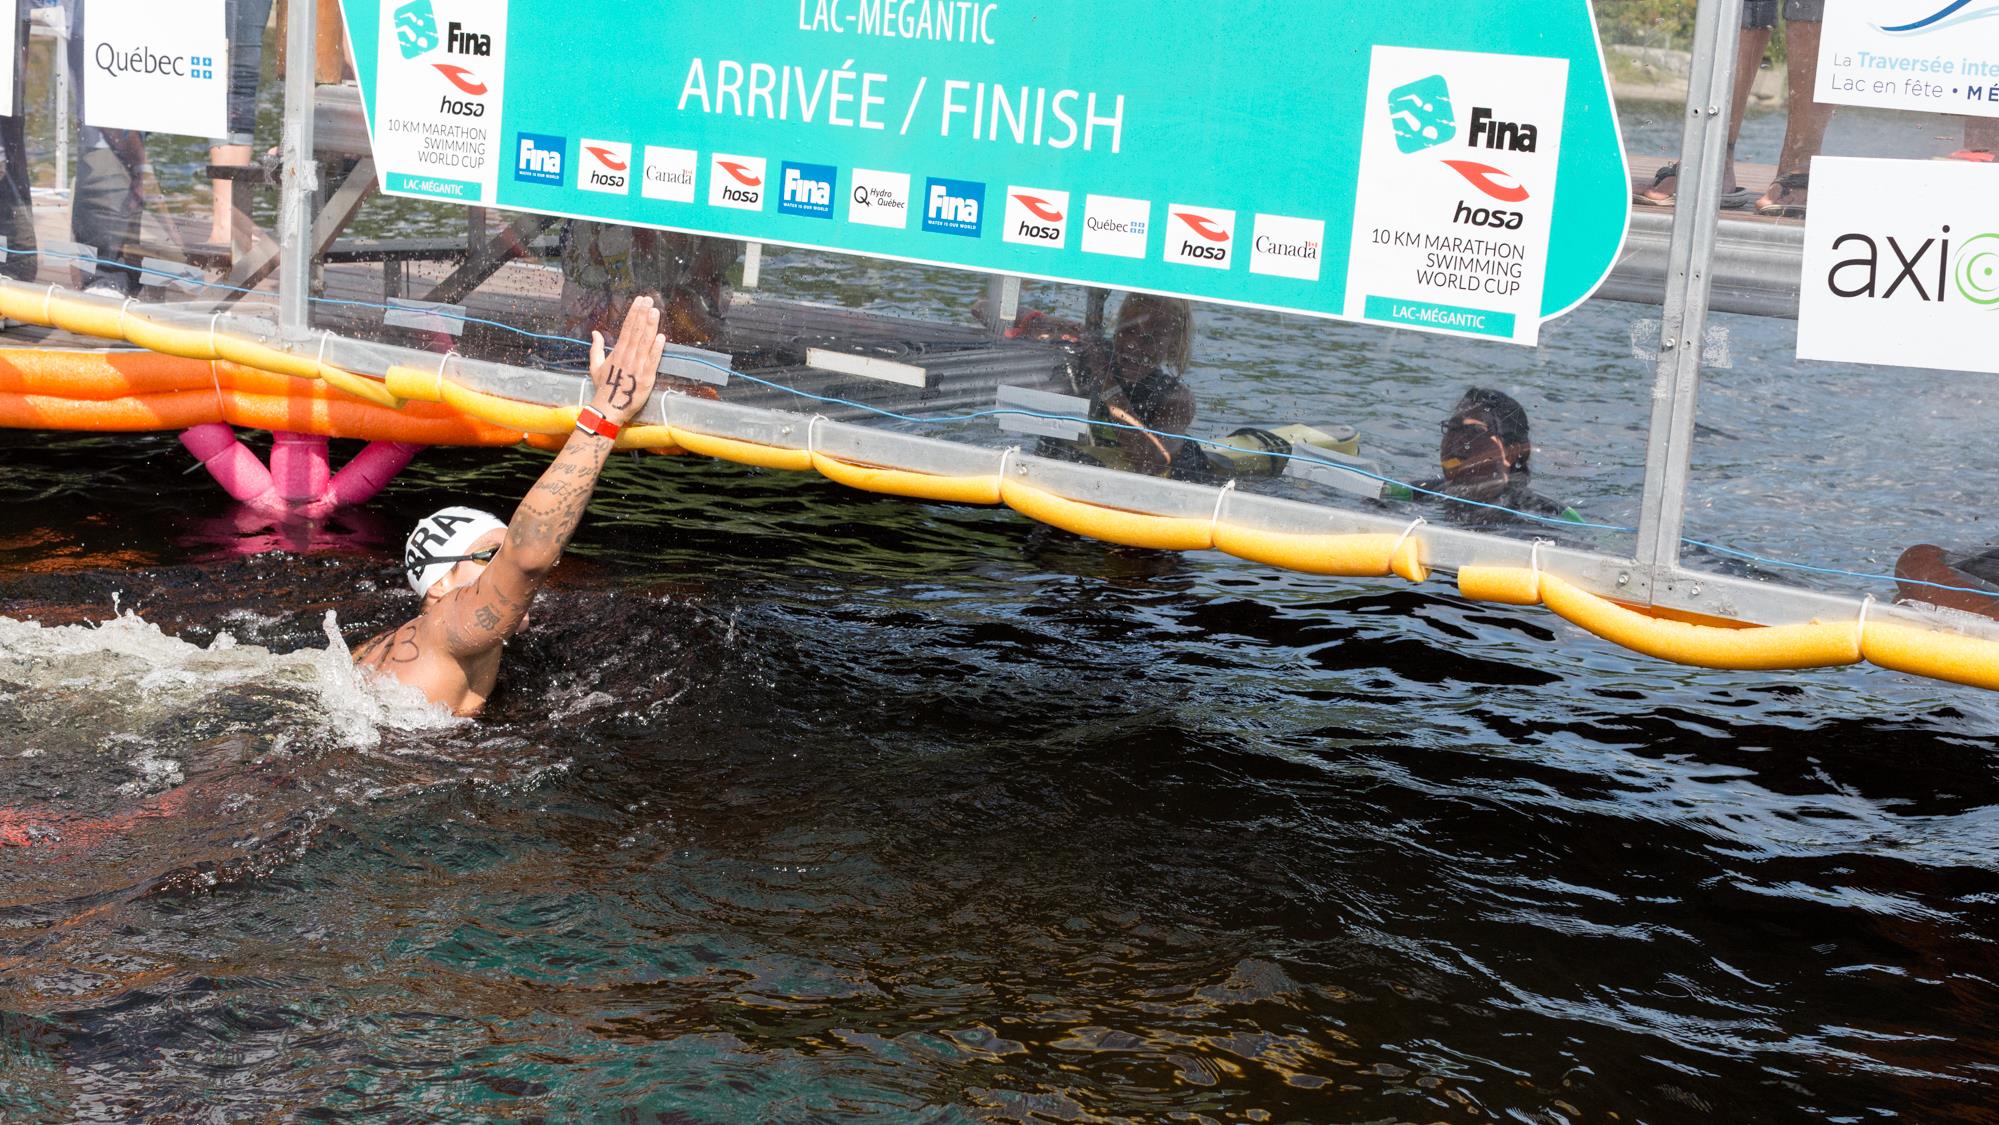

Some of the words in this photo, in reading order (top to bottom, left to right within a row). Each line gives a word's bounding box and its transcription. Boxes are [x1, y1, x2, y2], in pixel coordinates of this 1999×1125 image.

[447, 22, 491, 56] Fina
[95, 42, 185, 77] Québec
[1833, 53, 1852, 67] La
[1857, 51, 1954, 74] Traversée
[1831, 74, 1866, 92] Lac
[1873, 80, 1896, 95] en
[1904, 78, 1943, 98] fête
[440, 95, 485, 117] hosa
[677, 57, 888, 130] ARRIVÉE
[899, 76, 927, 135] /
[940, 79, 1125, 154] FINISH
[388, 119, 401, 132] 10
[402, 120, 420, 134] KM
[422, 122, 487, 141] MARATHON
[1468, 106, 1538, 153] Fina
[424, 136, 486, 156] SWIMMING
[519, 138, 561, 174] Fina
[418, 151, 460, 167] WORLD
[462, 155, 485, 169] CUP
[403, 178, 464, 195] LAC-MÉGANTIC
[590, 170, 625, 187] hosa
[646, 165, 693, 185] Canada
[783, 168, 831, 205] Fina
[722, 185, 759, 203] hosa
[870, 187, 893, 200] Hydro
[877, 197, 905, 209] Québec
[928, 184, 979, 223] Fina
[1086, 216, 1129, 234] Québec
[1452, 200, 1524, 230] hosa
[1018, 220, 1060, 241] hosa
[1180, 240, 1226, 261] hosa
[1255, 235, 1318, 260] Canada
[1371, 228, 1391, 244] 10
[1394, 230, 1421, 249] KM
[1424, 234, 1525, 261] MARATHON
[1426, 252, 1522, 278] SWIMMING
[1416, 269, 1480, 292] WORLD
[1484, 278, 1520, 296] CUP
[1392, 305, 1486, 329] LAC-MÉGANTIC
[605, 363, 637, 411] 43
[407, 515, 476, 582] BRA
